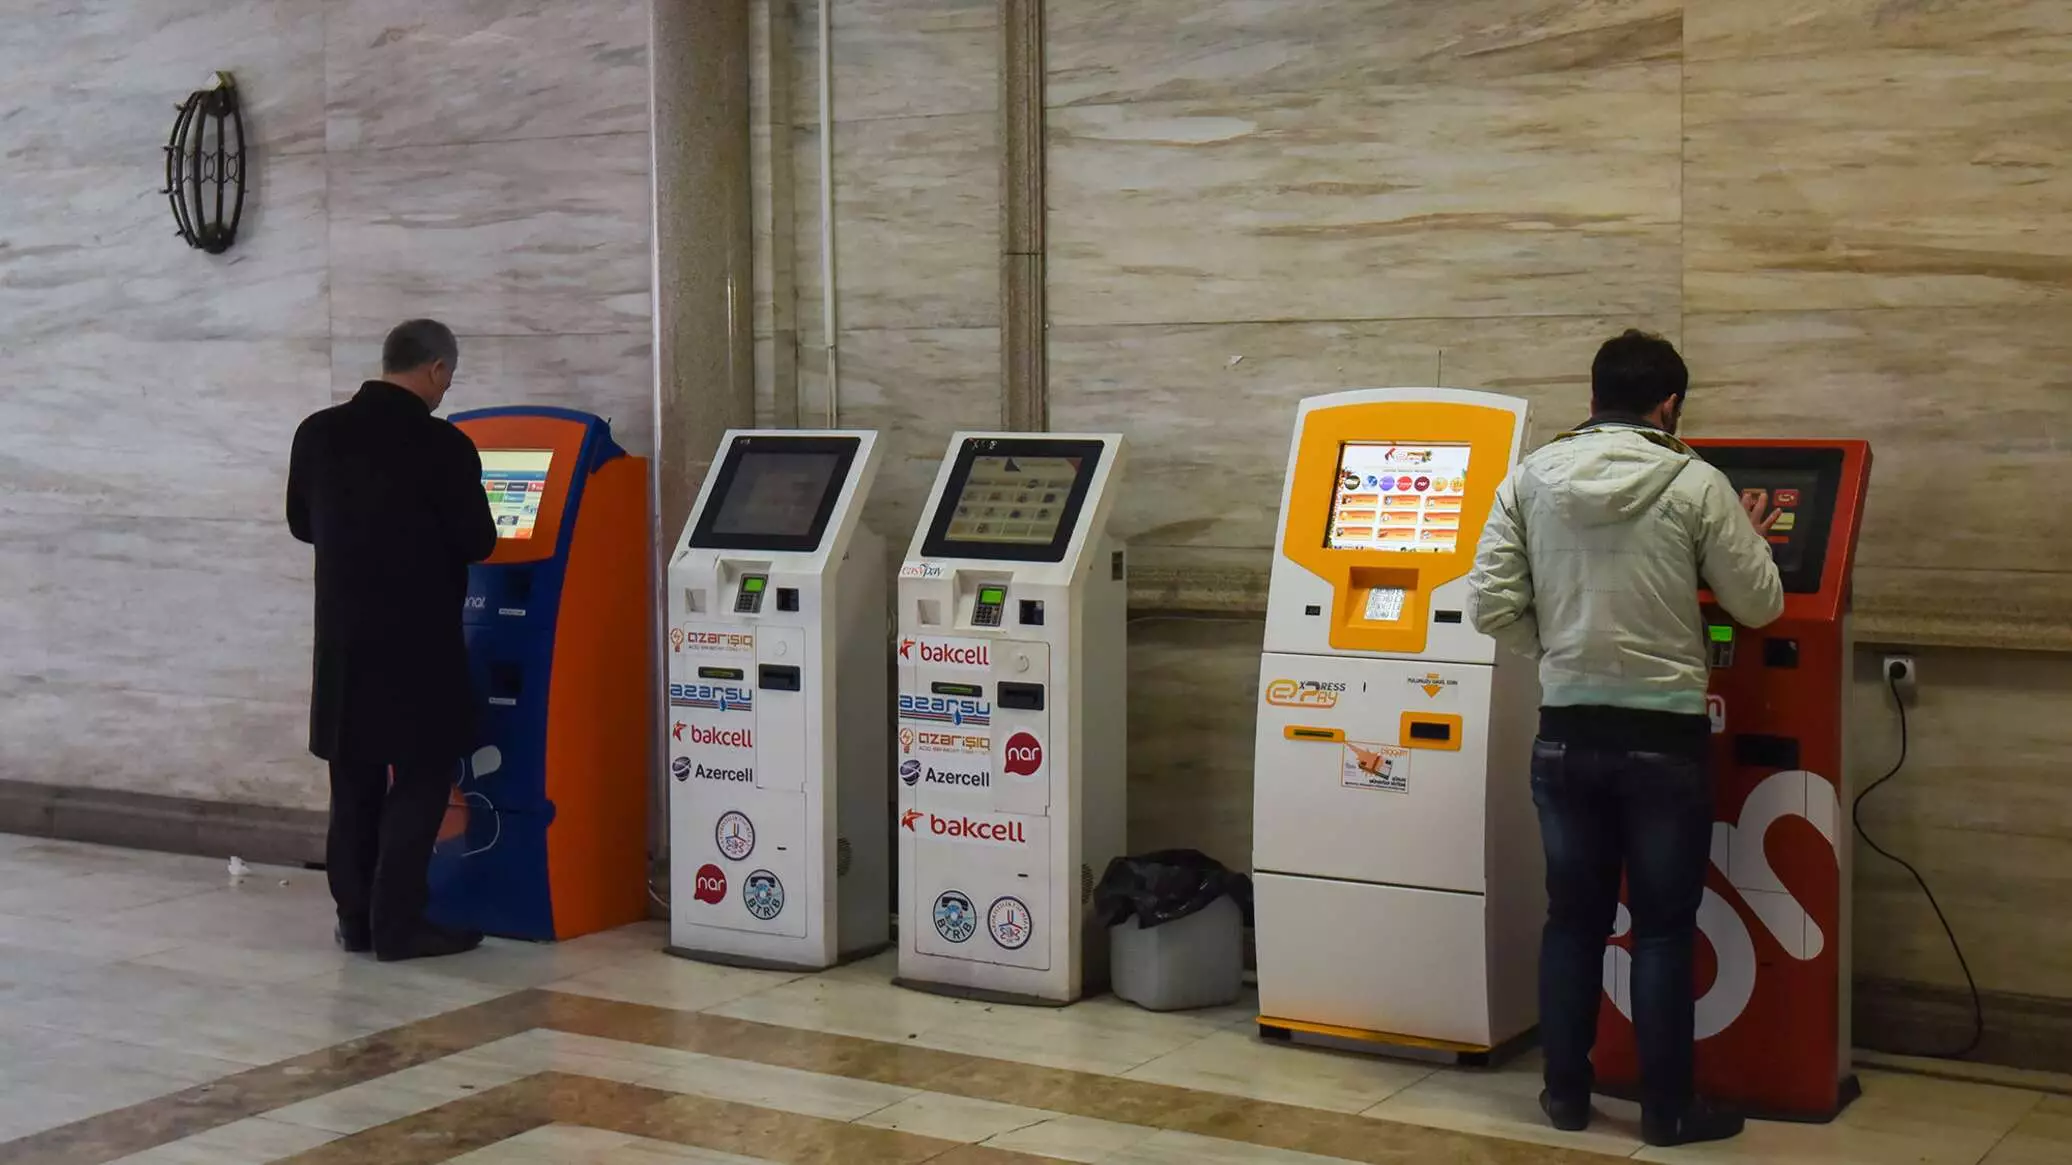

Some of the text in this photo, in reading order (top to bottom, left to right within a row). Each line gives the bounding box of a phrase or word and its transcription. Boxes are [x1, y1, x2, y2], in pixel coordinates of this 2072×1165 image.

[920, 642, 989, 665] bakcell
[691, 725, 753, 748] bakcell
[1008, 747, 1040, 761] nar
[695, 763, 753, 782] Azercell
[925, 768, 990, 787] Azercell
[930, 814, 1026, 843] bakcell
[697, 877, 725, 891] nar
